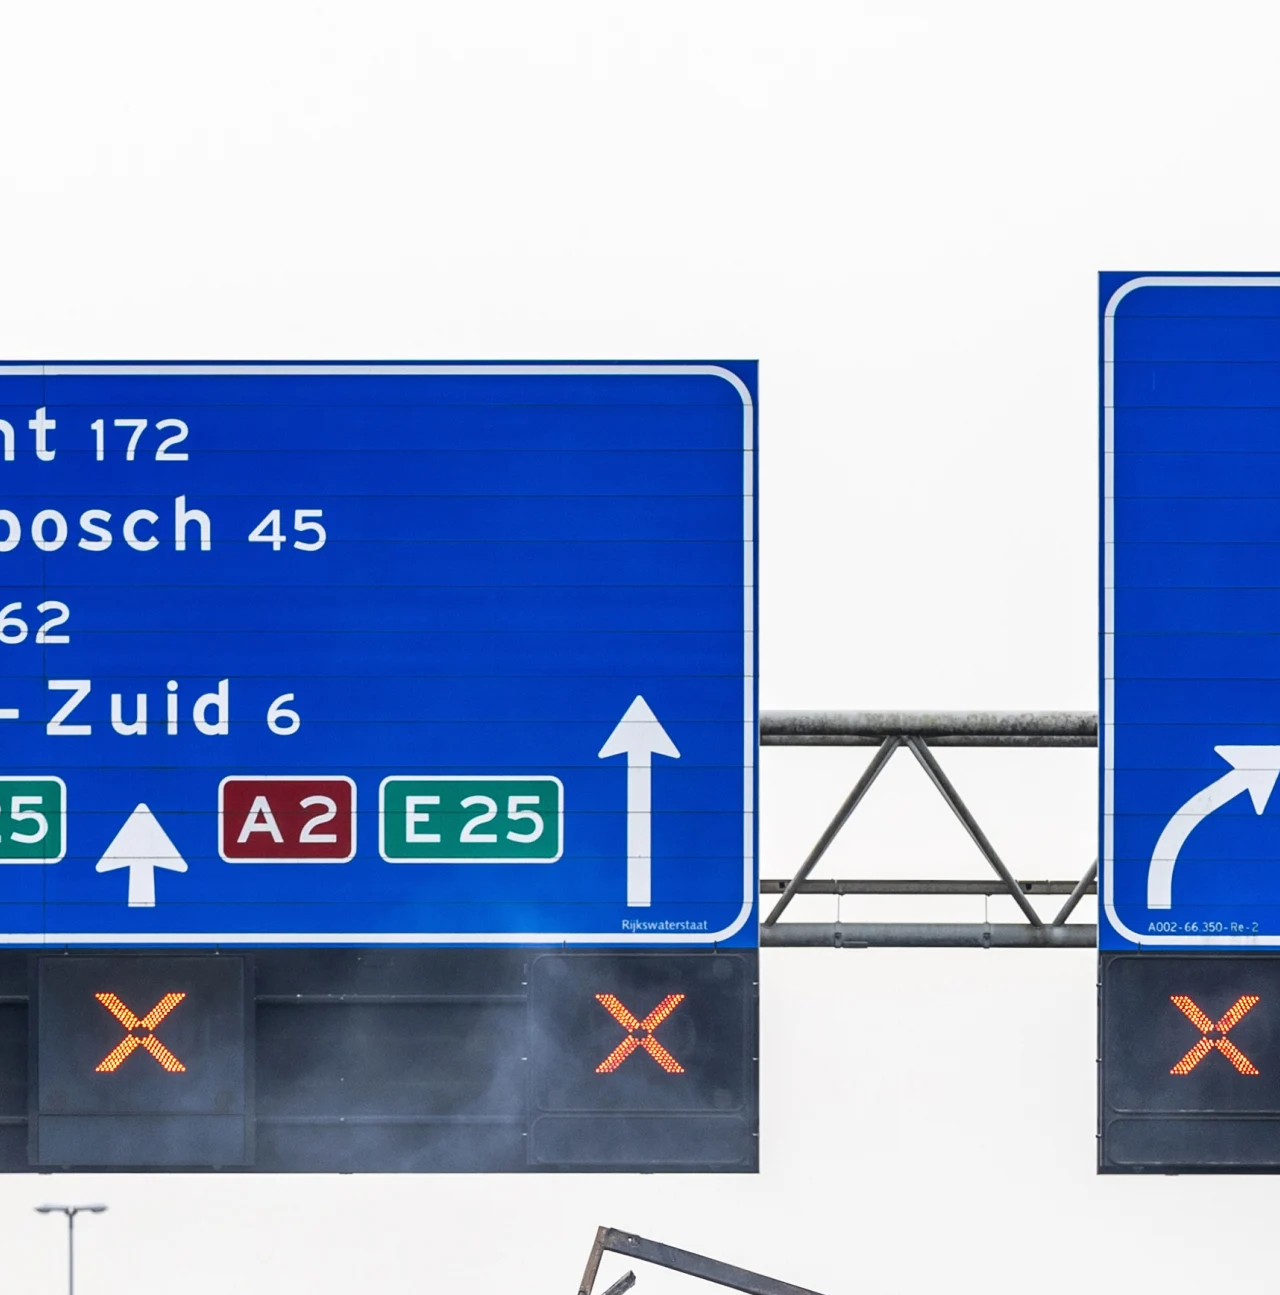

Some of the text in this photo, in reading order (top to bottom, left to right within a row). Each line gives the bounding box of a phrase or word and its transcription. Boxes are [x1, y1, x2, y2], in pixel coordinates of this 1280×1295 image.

[90, 418, 189, 461] 172
[248, 509, 327, 552] 45
[266, 693, 301, 736] 6
[621, 919, 708, 933] Rijkswaterstaat
